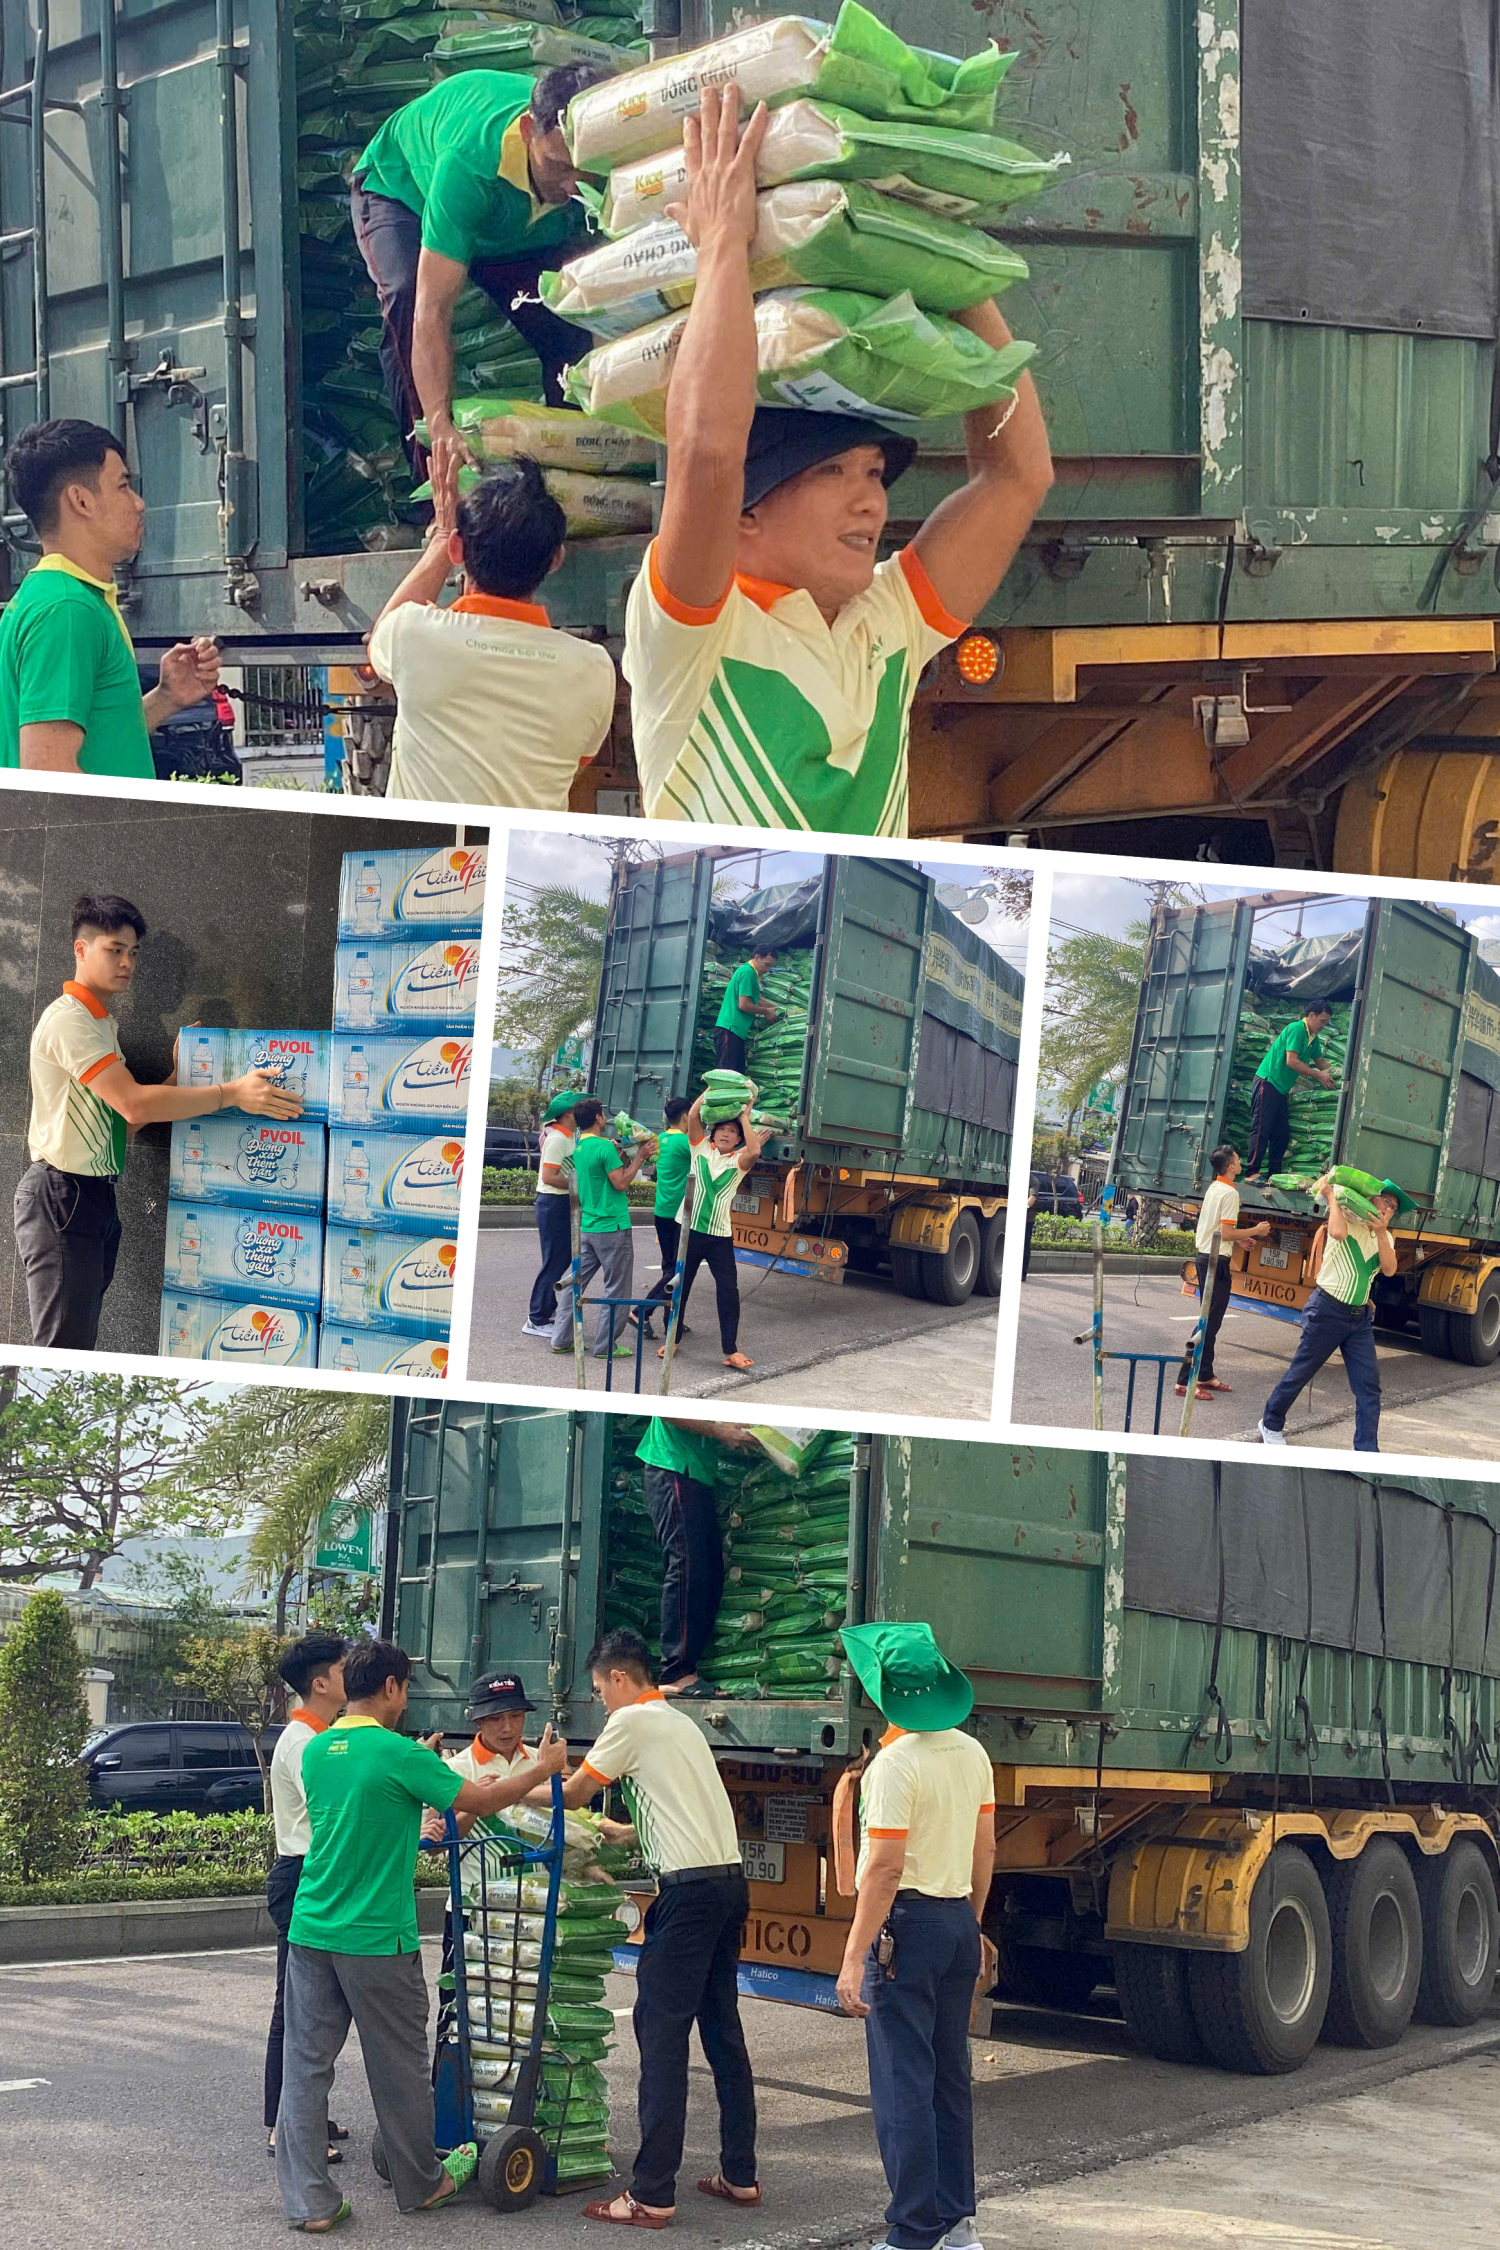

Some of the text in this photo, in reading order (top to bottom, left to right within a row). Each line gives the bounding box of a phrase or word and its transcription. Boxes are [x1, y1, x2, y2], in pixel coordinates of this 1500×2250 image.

[268, 1040, 314, 1054] PVOIL
[260, 1129, 305, 1145] PVOIL
[257, 1222, 303, 1240] PVOIL
[1269, 1249, 1281, 1258] 15R
[1243, 1277, 1296, 1302] HATICO
[750, 1966, 779, 1981] Hatico
